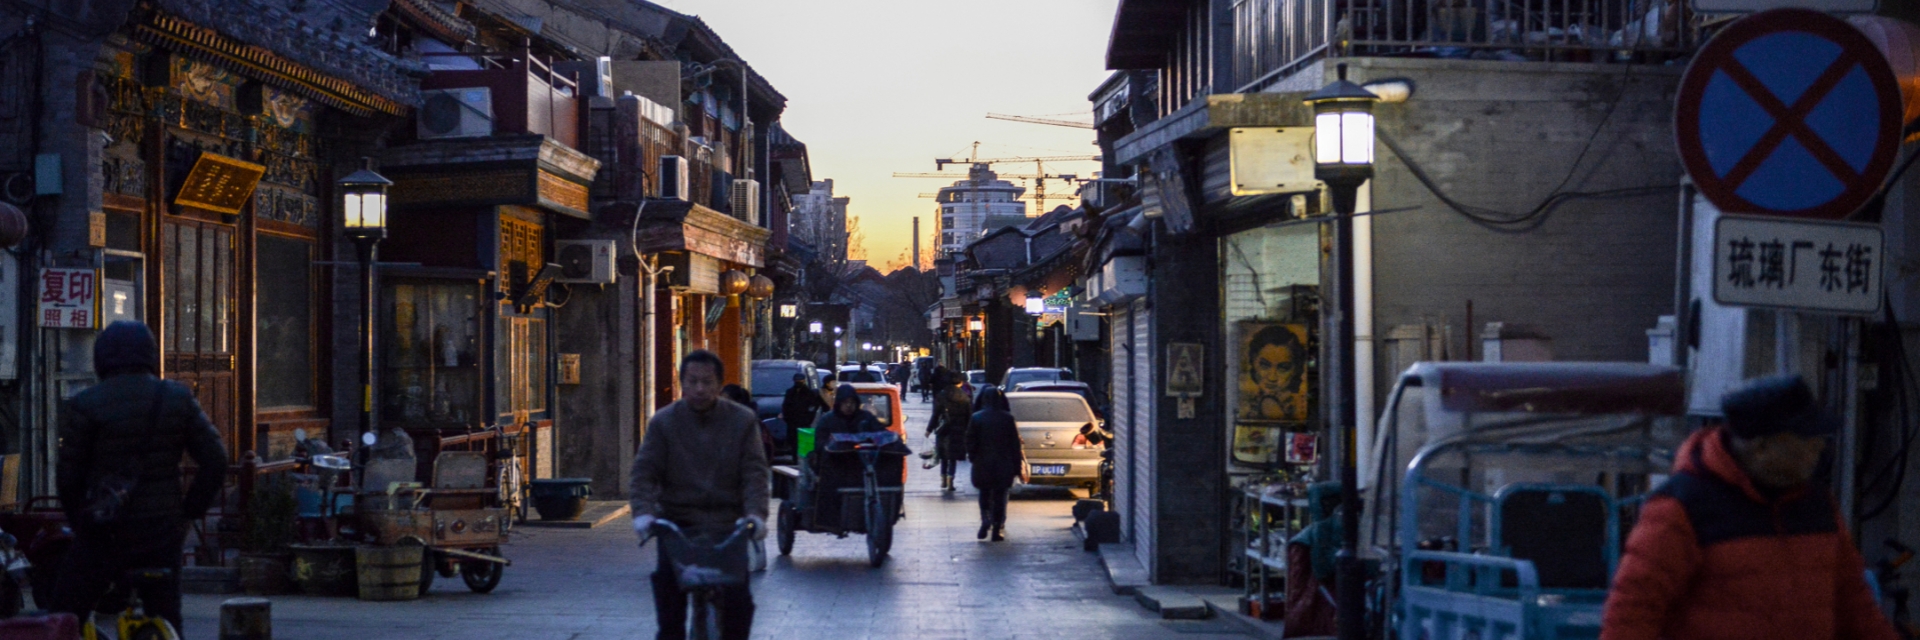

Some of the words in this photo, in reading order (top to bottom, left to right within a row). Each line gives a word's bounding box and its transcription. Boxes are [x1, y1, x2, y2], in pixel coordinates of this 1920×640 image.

[1728, 236, 1872, 294] 琉璃厂东街
[42, 269, 92, 304] 复印
[44, 309, 88, 327] 照相
